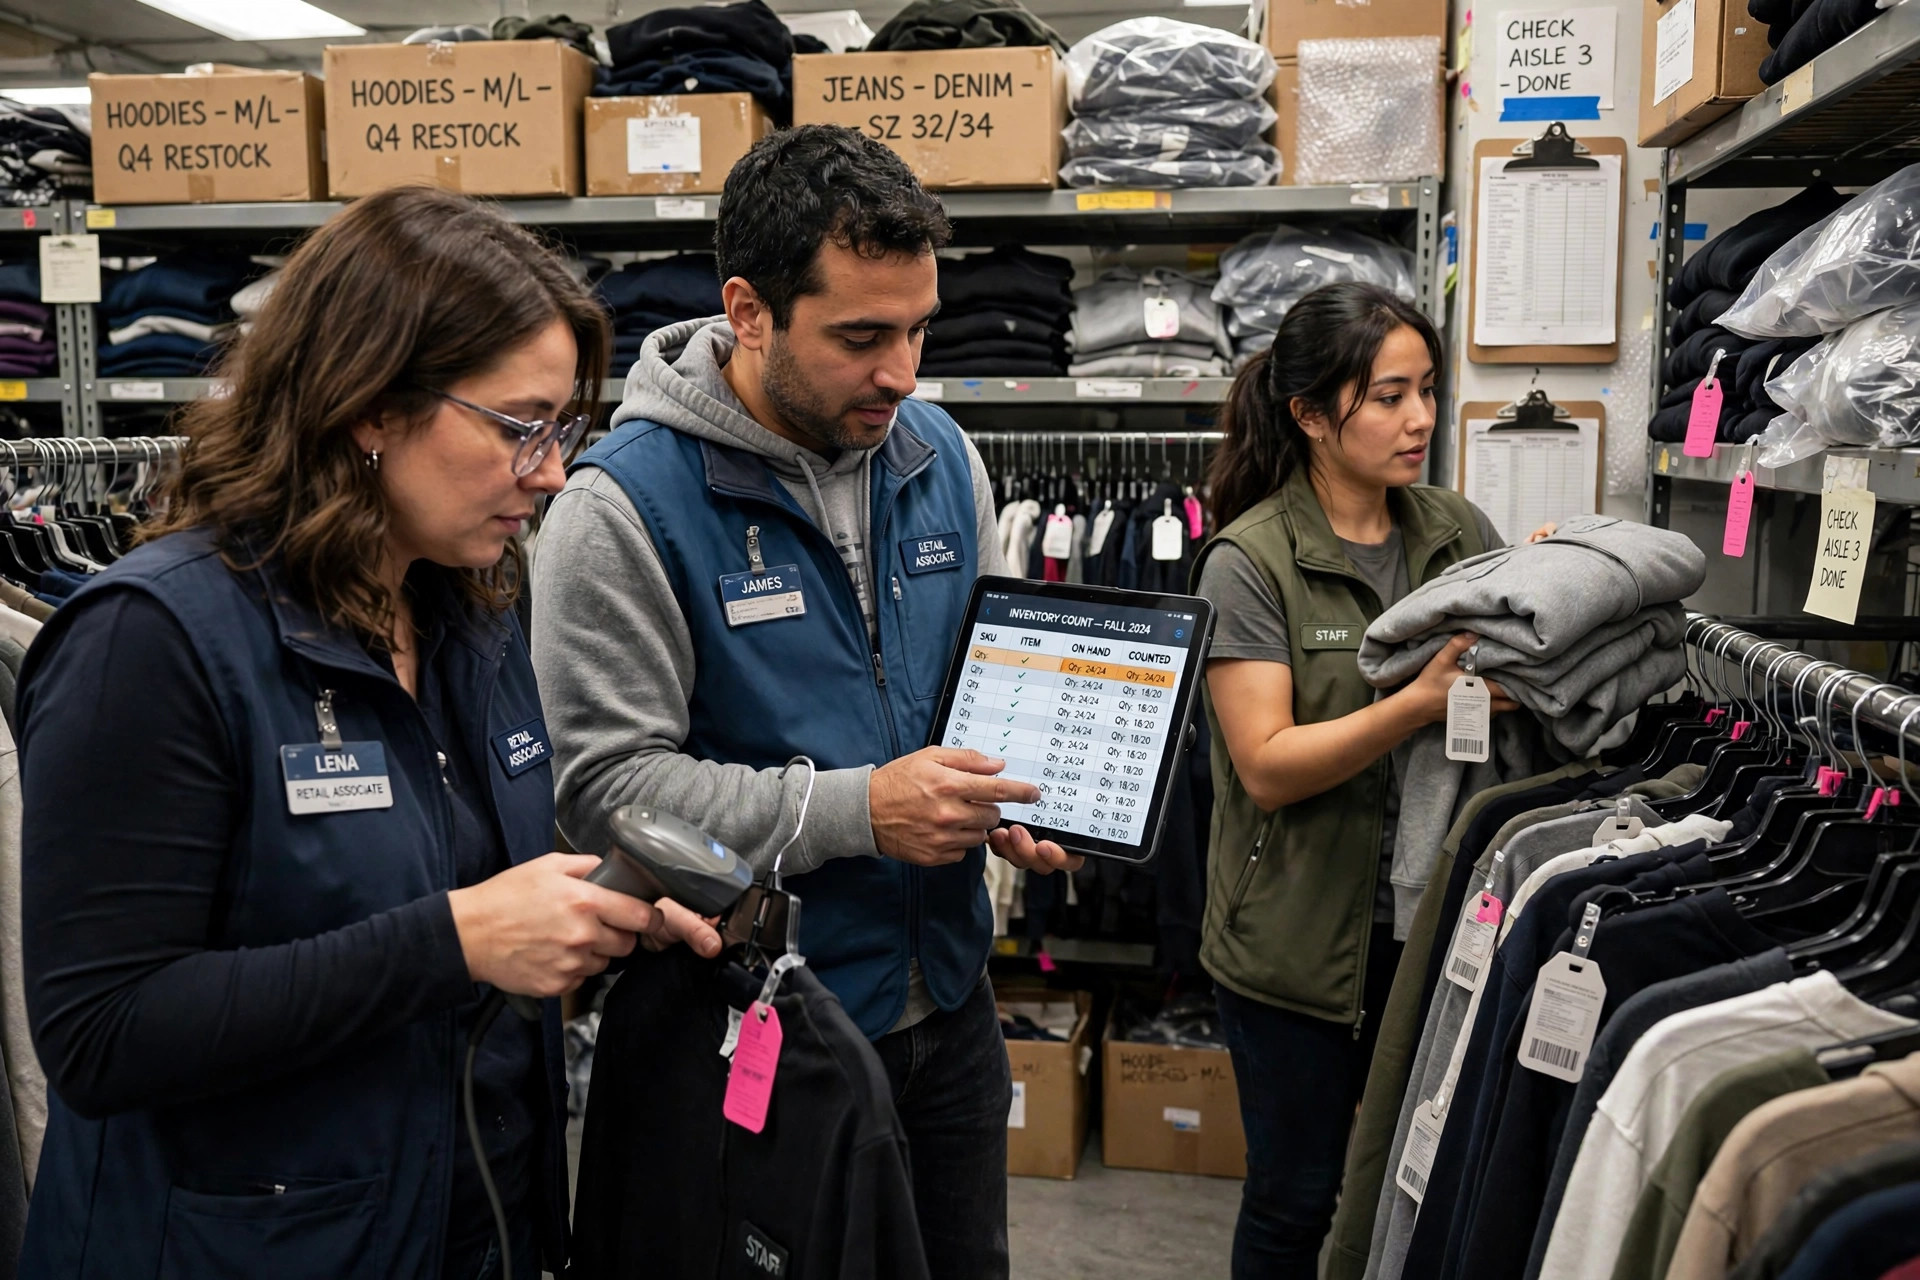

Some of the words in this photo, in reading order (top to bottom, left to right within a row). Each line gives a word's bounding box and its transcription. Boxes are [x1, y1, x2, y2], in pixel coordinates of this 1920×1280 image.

[1507, 19, 1575, 40] CHECK
[1509, 46, 1566, 68] AISLE
[1578, 44, 1592, 65] 3
[351, 78, 455, 107] HOODIES
[484, 72, 531, 108] M/L
[822, 75, 905, 103] JEANS
[934, 72, 1012, 100] DENIM
[1518, 72, 1571, 94] DONE
[106, 100, 207, 129] HOODIES
[235, 95, 281, 130] M/L
[366, 123, 401, 153] Q4
[412, 122, 521, 150] RESTOCK
[869, 114, 902, 140] SZ
[912, 109, 994, 143] 32/34
[118, 143, 153, 173] Q4
[164, 143, 271, 171] RESTOCK
[1827, 508, 1858, 530] CHECK
[1823, 537, 1850, 559] AISLE
[1852, 540, 1860, 561] 3
[741, 576, 783, 594] JAMES
[1820, 567, 1847, 589] DONE
[1009, 608, 1061, 622] INVENTORY
[1061, 615, 1094, 627] COUNT
[1104, 620, 1126, 632] FALL
[1128, 623, 1151, 634] 2024
[1316, 630, 1348, 641] STAFF
[980, 632, 997, 642] SKU
[1020, 637, 1041, 647] ITEM
[1072, 643, 1085, 653] ON
[1087, 646, 1111, 657] HAND
[1128, 651, 1171, 664] COUNTED
[315, 754, 359, 773] LENA
[296, 787, 330, 800] RETAIL
[333, 783, 384, 797] ASSOCIATE
